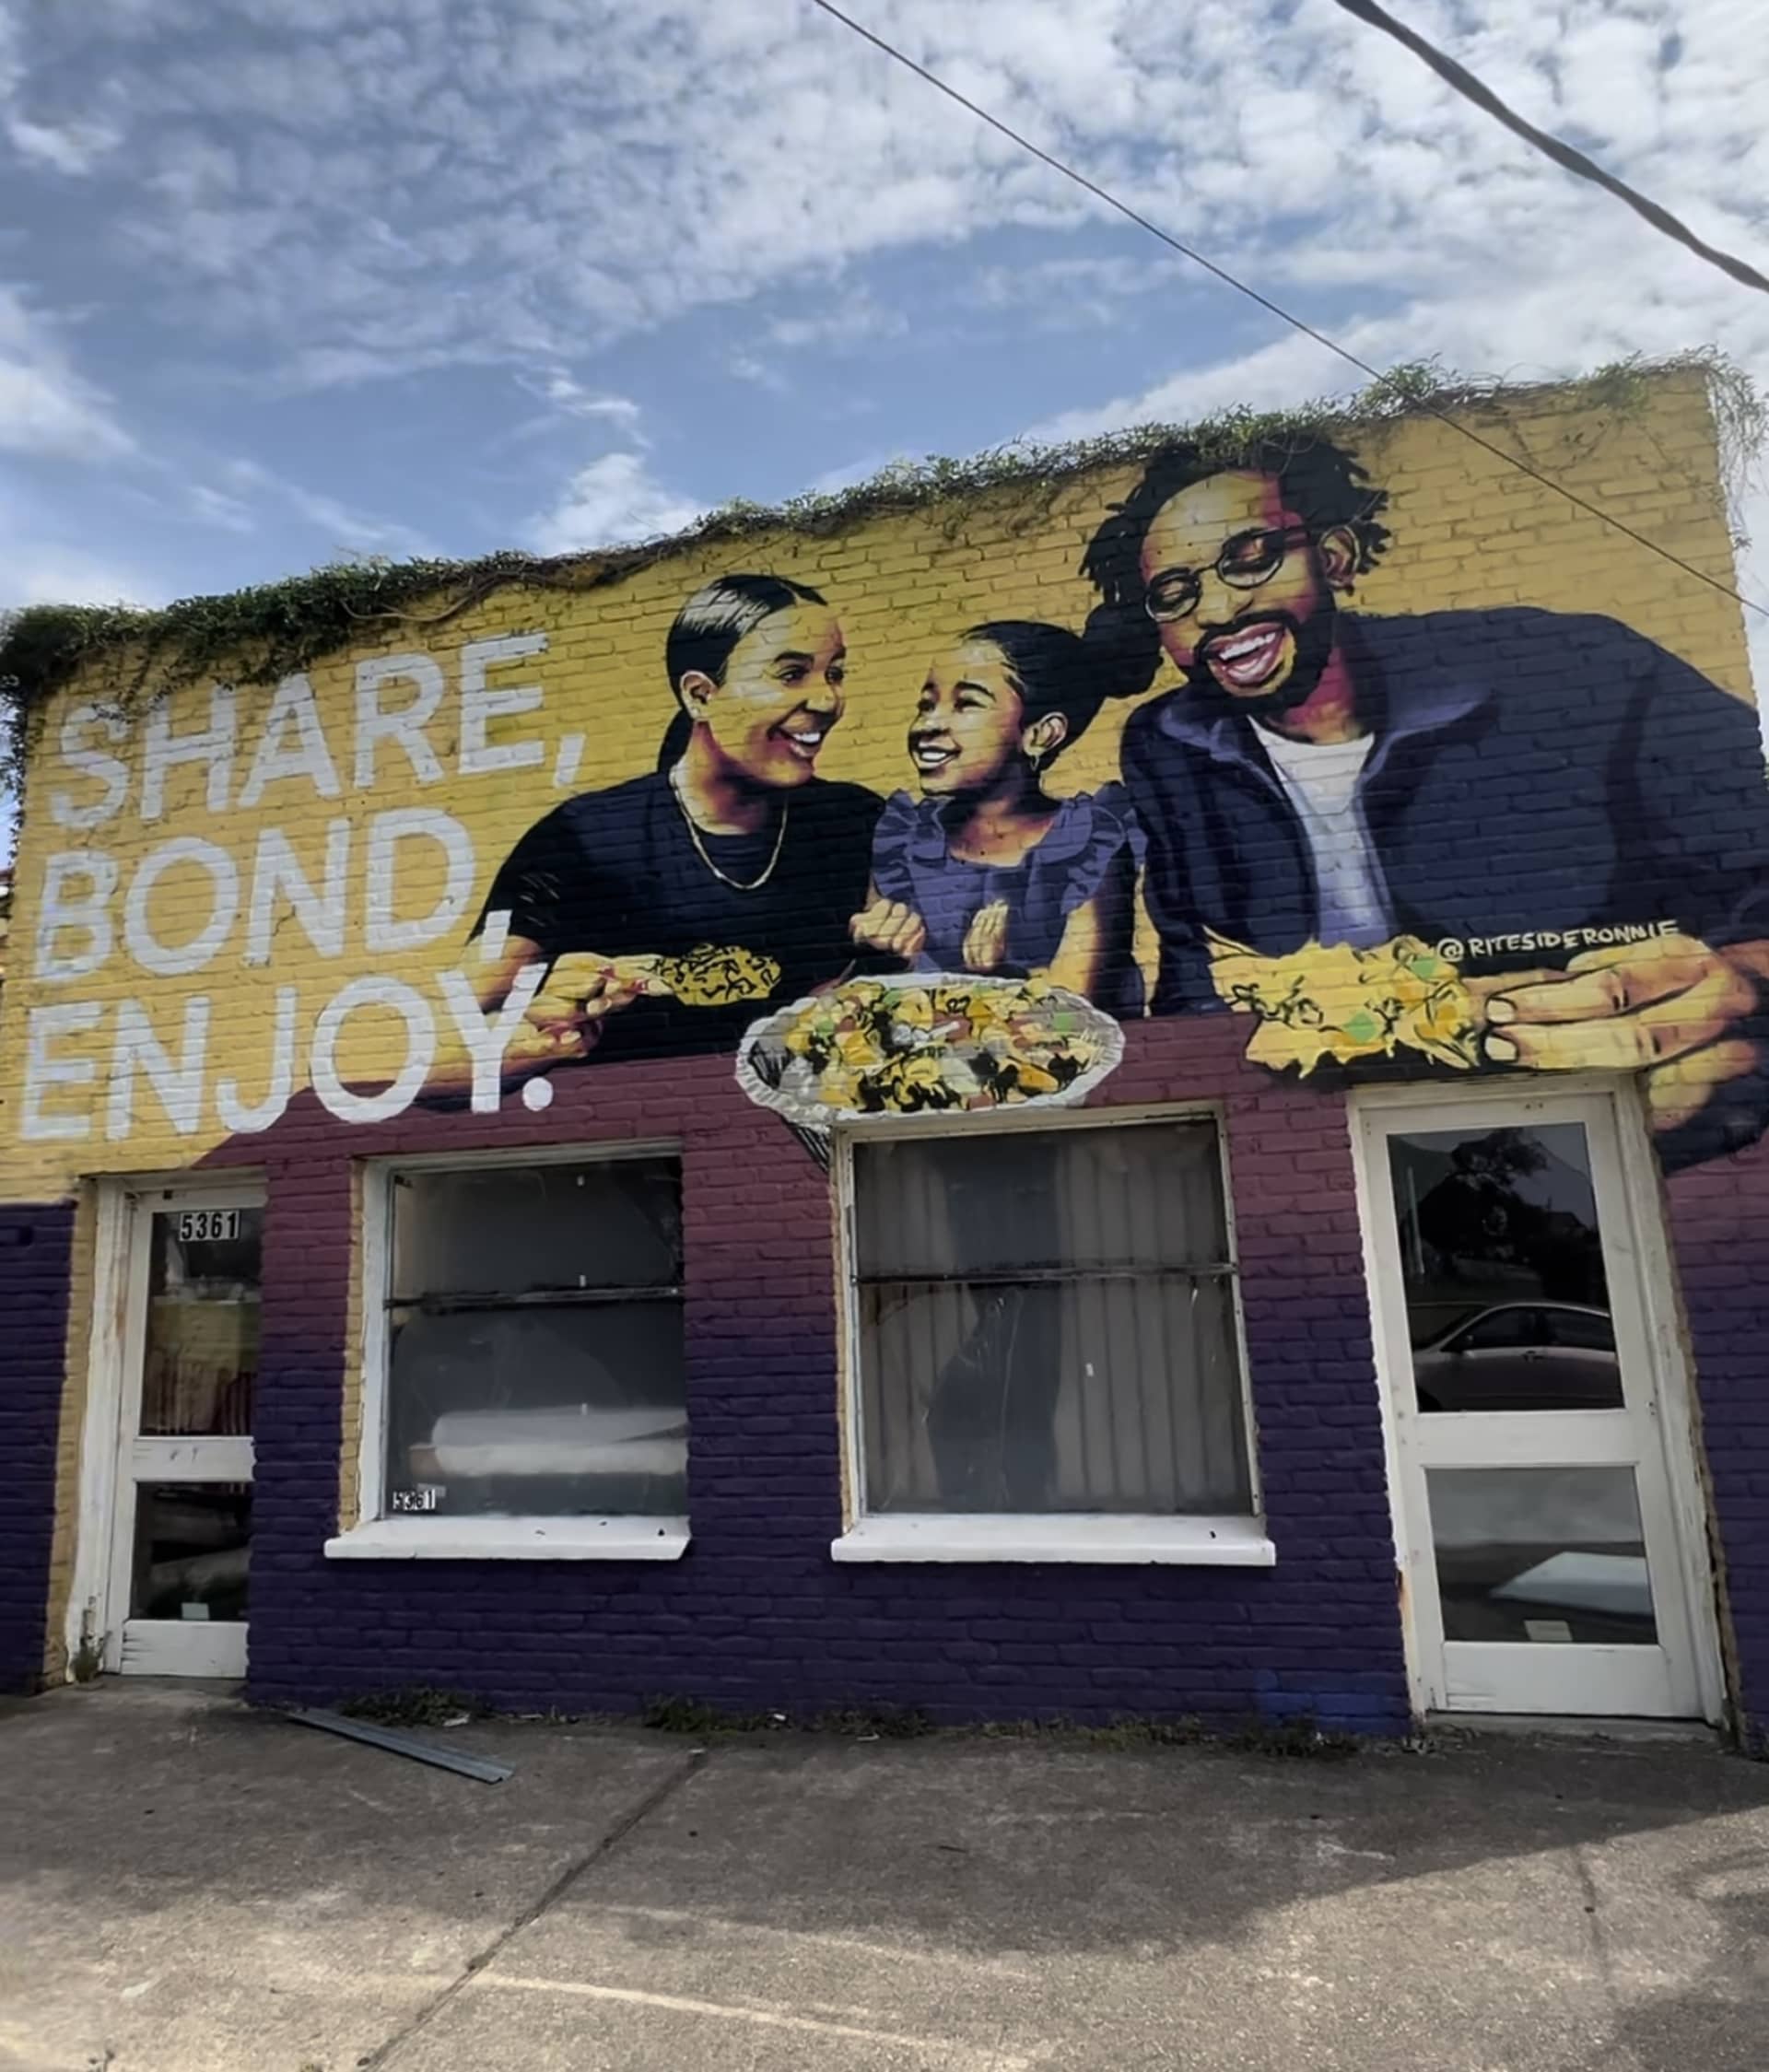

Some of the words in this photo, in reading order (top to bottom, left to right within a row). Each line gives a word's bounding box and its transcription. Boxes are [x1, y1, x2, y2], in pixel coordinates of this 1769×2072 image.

[51, 631, 587, 828] SHARE,
[34, 807, 513, 983] BOND,
[1435, 919, 1680, 963] @RITESIDERONNIE
[18, 962, 554, 1142] ENJOY.
[182, 1212, 237, 1239] 5361
